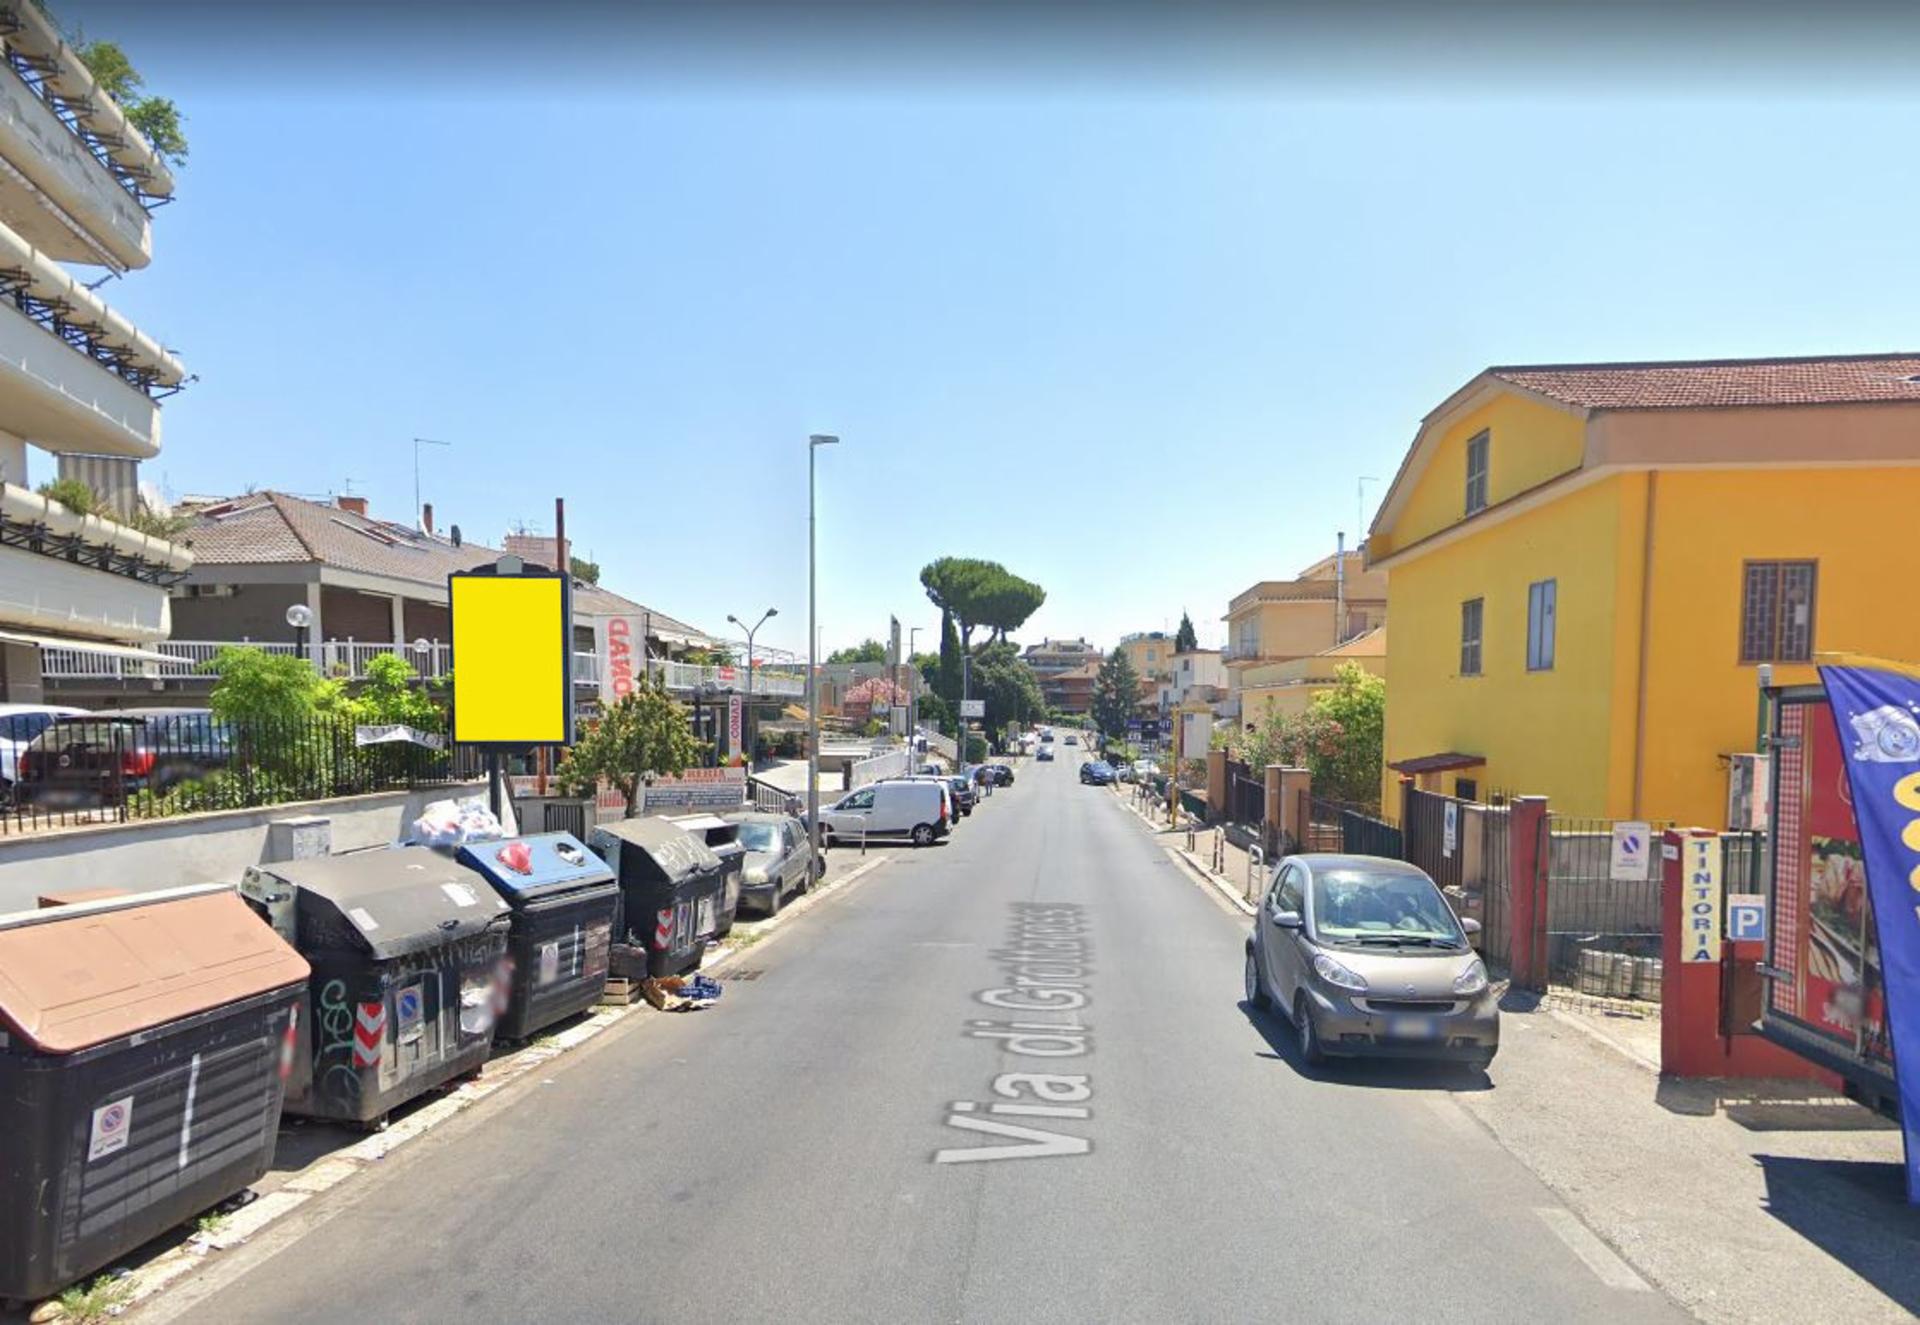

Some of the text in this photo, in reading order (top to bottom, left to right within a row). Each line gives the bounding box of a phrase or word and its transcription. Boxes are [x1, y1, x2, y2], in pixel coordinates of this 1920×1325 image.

[730, 698, 740, 738] CONAD
[1693, 841, 1712, 960] TINTORIA
[1737, 909, 1760, 936] P
